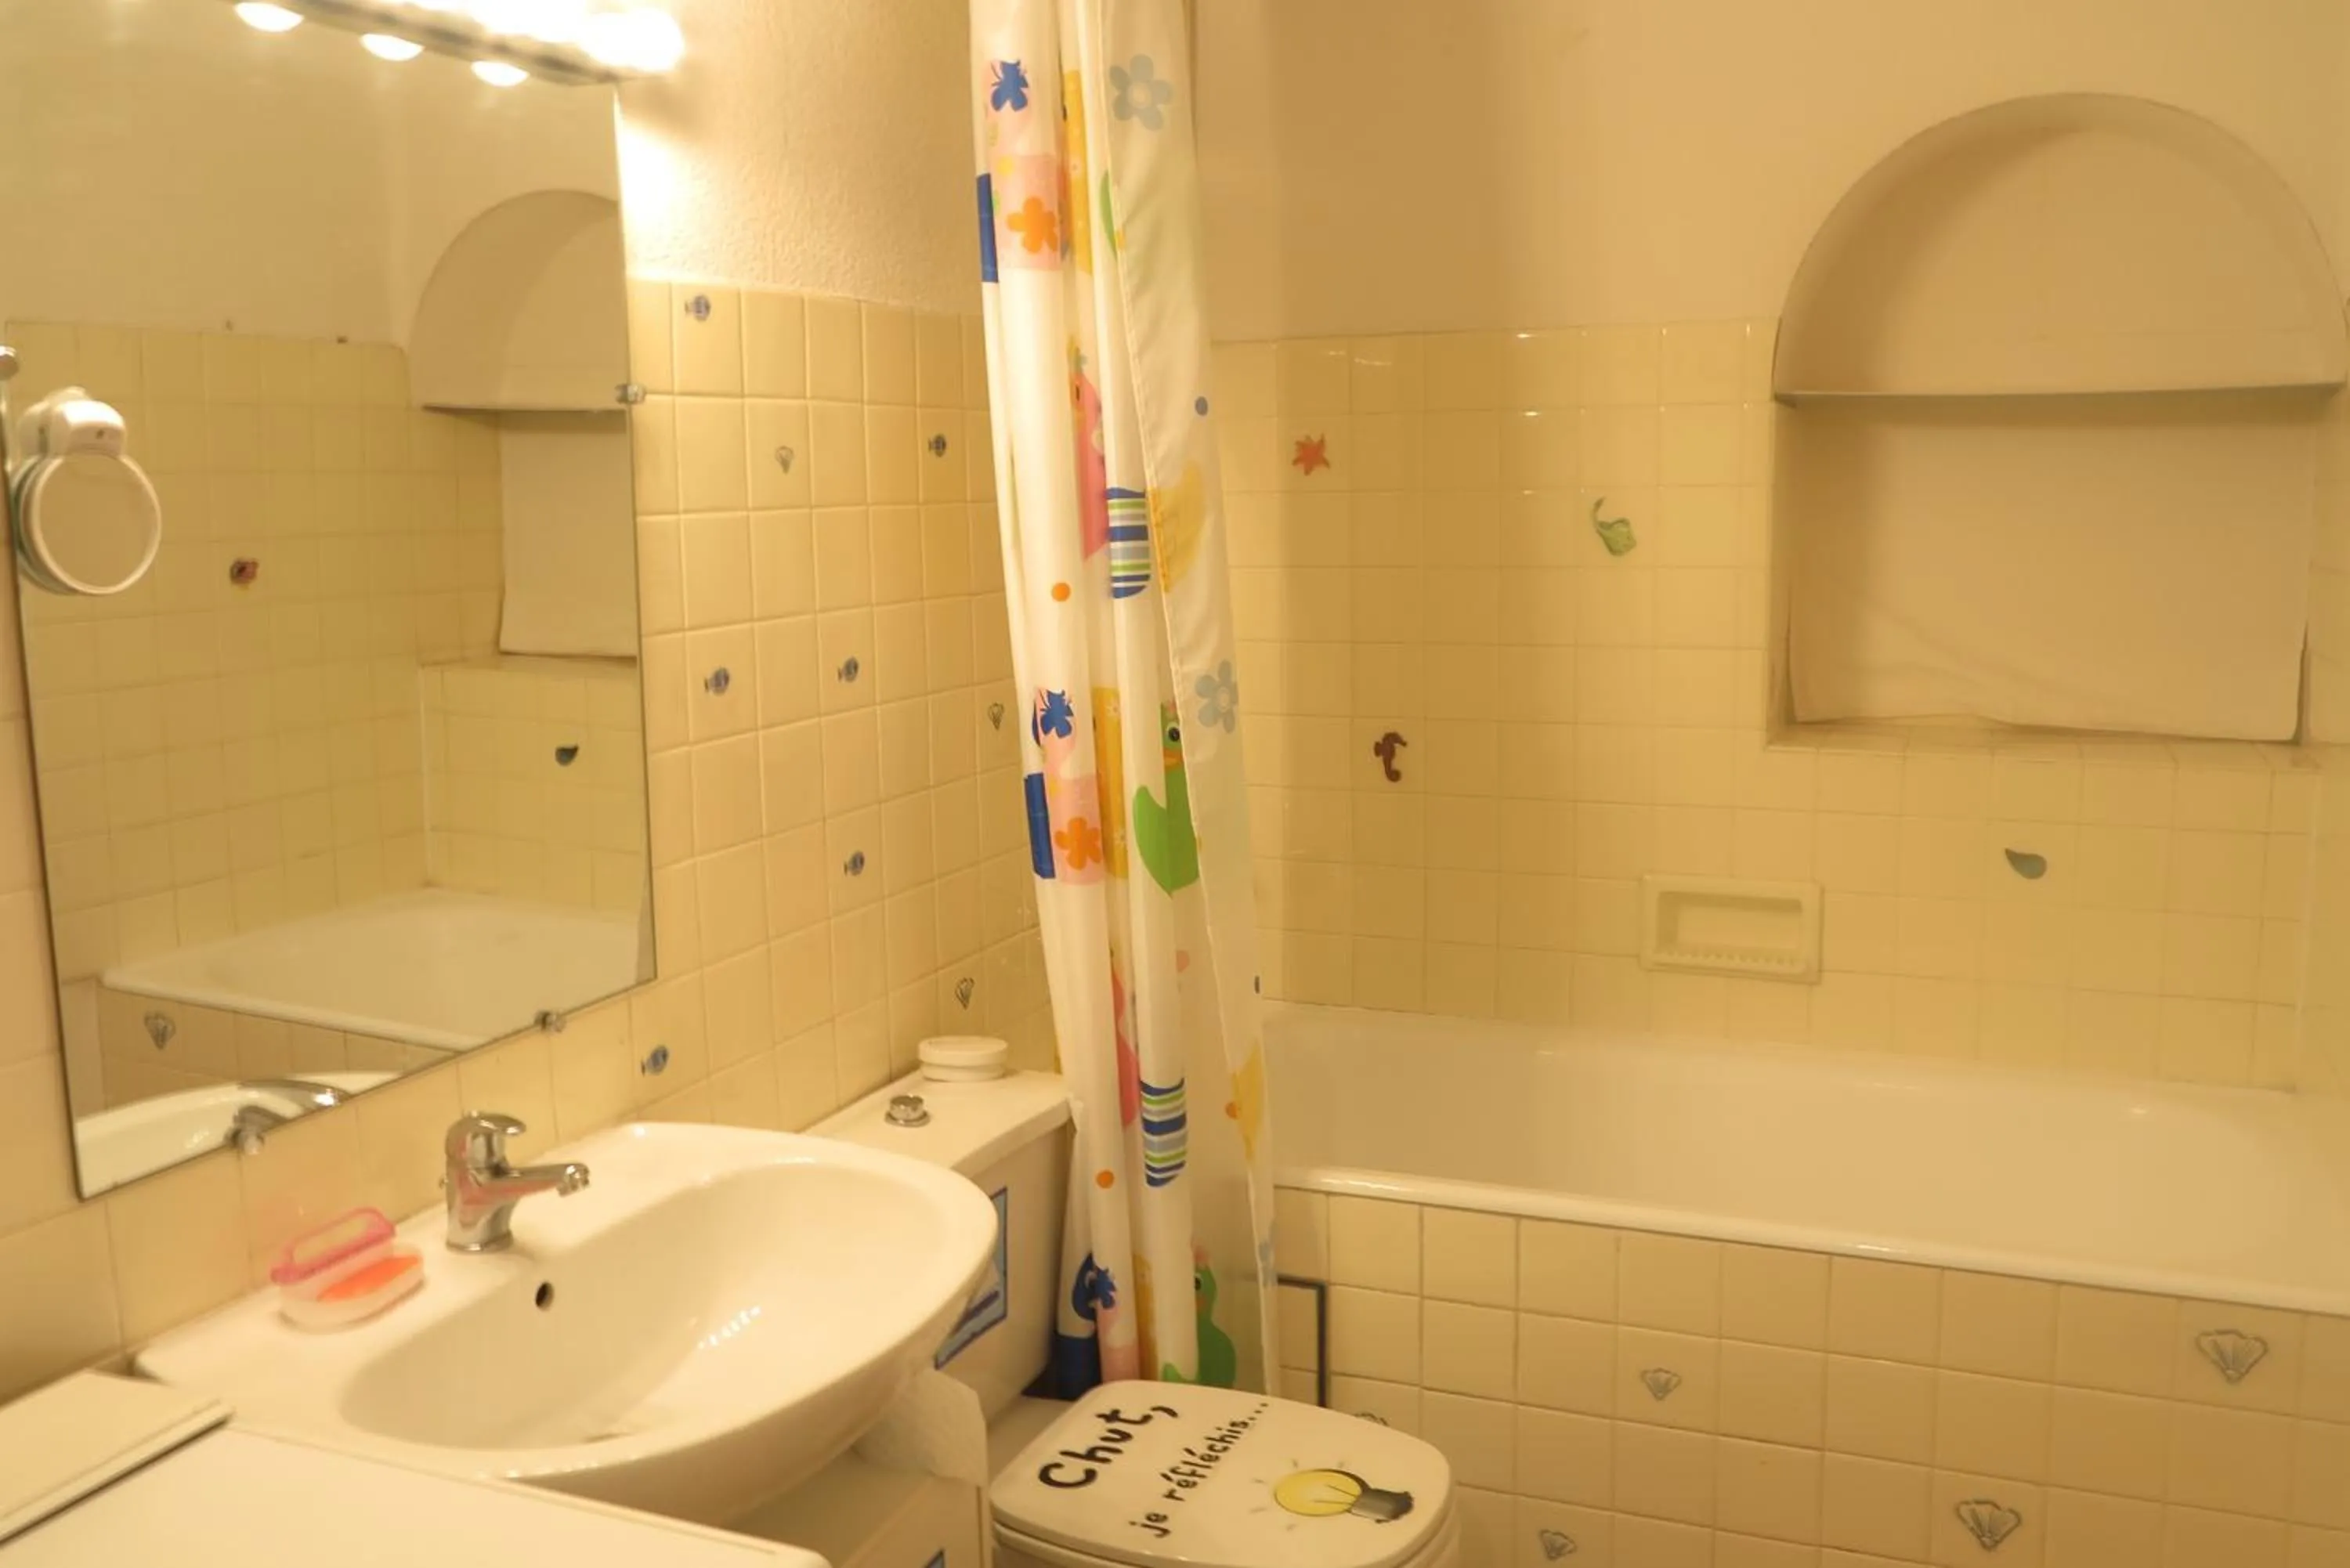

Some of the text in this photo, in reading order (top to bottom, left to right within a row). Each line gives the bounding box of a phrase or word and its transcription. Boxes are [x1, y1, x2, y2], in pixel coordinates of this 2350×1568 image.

[1039, 1406, 1178, 1488] Chut,
[1129, 1403, 1269, 1537] je réfléchis...
